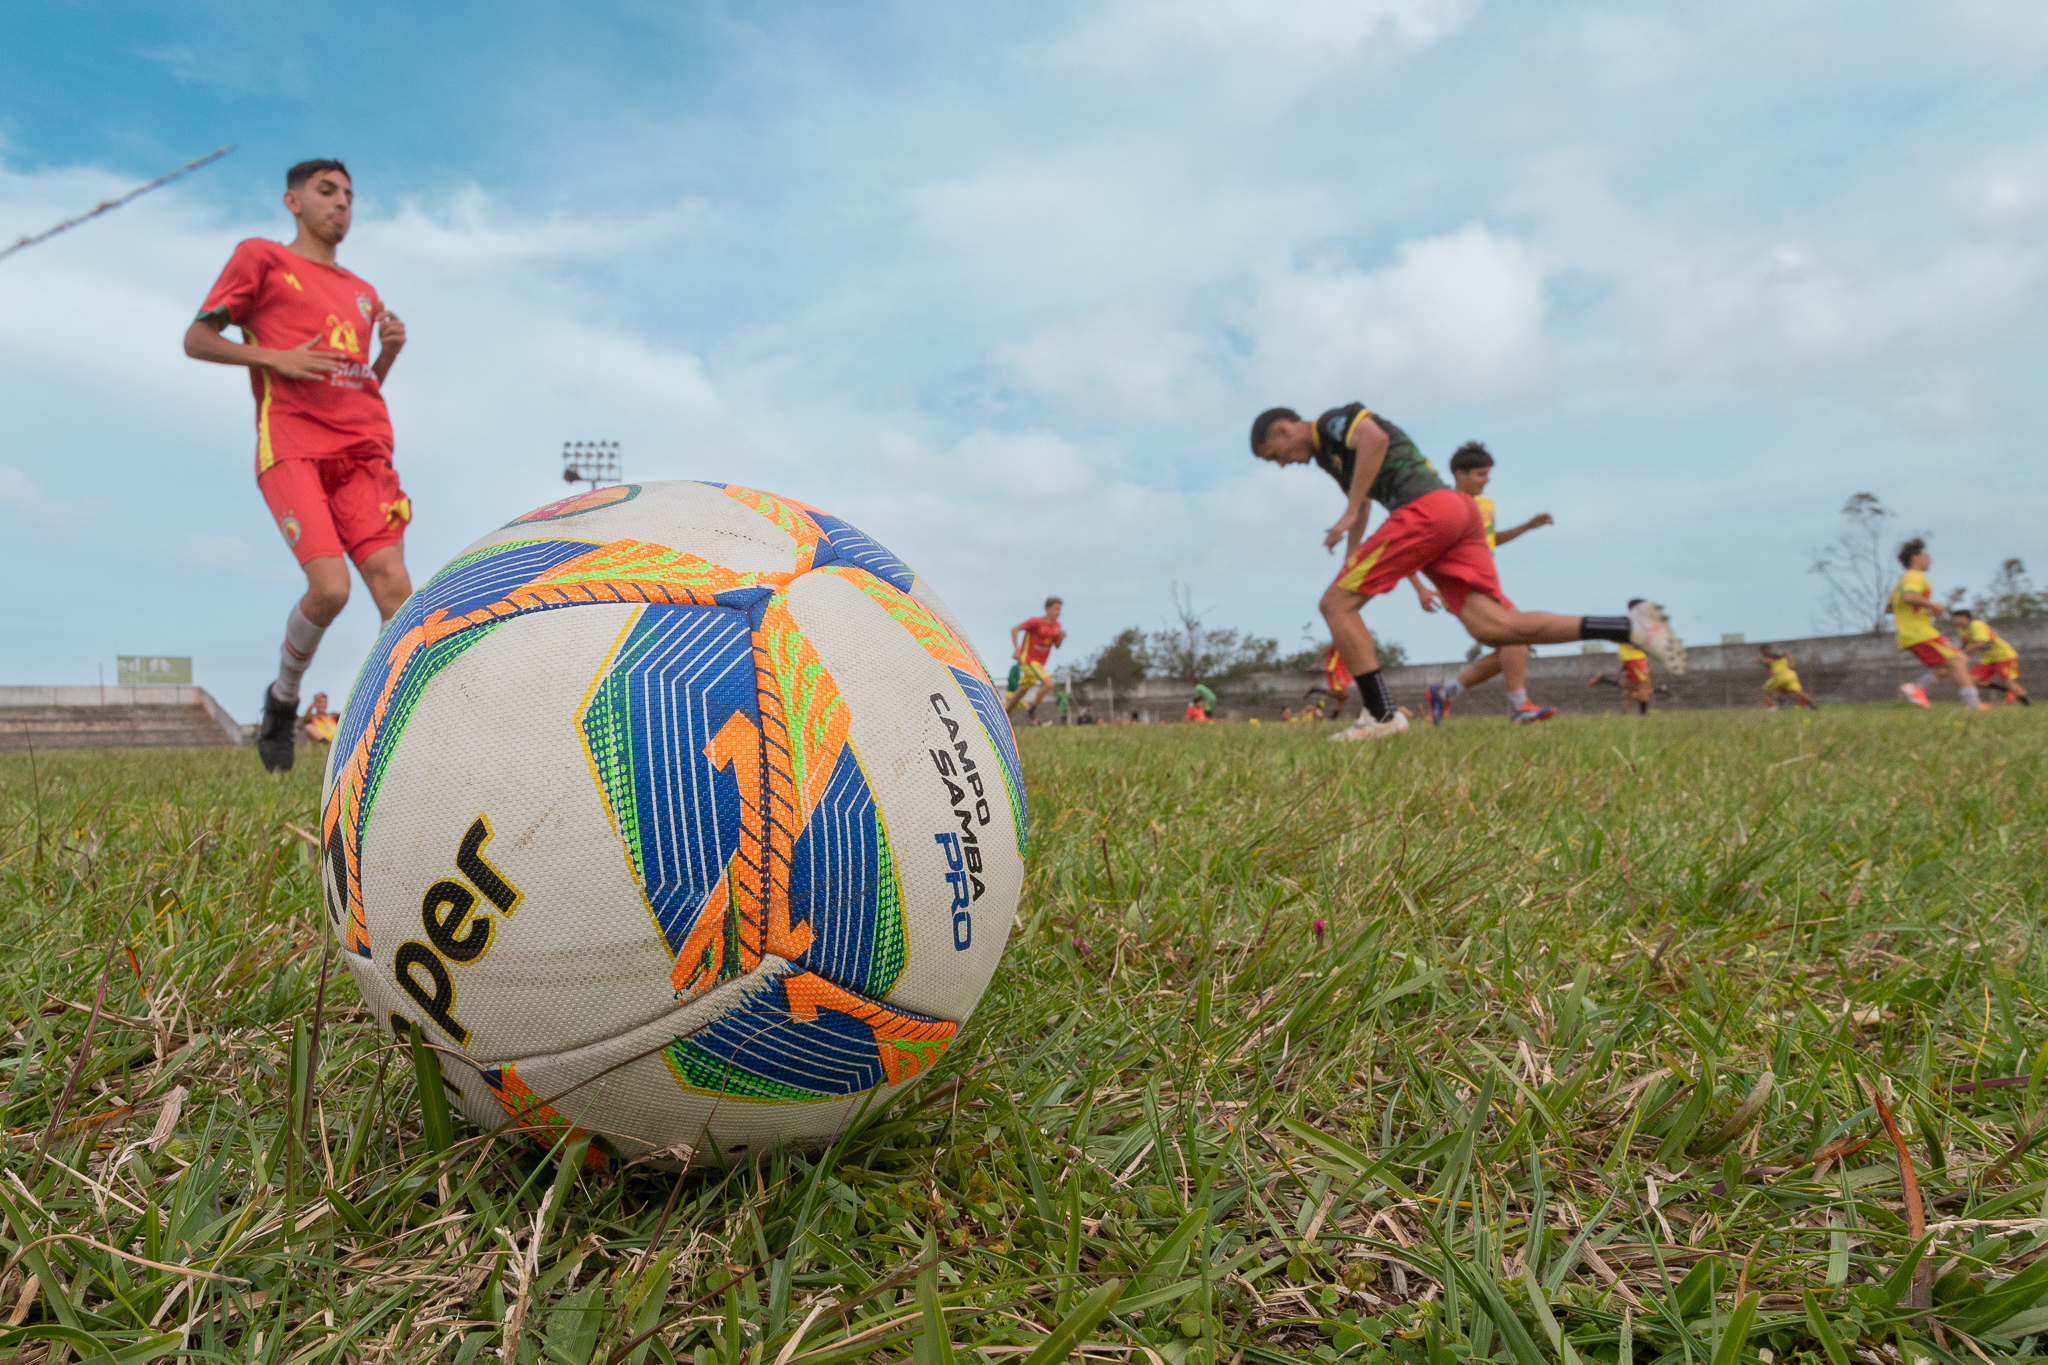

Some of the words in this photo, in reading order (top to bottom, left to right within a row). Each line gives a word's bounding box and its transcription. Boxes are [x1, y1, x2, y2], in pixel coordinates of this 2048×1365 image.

[928, 748, 986, 902] SAMBA
[929, 692, 991, 827] CAMPO
[934, 832, 971, 952] PRO
